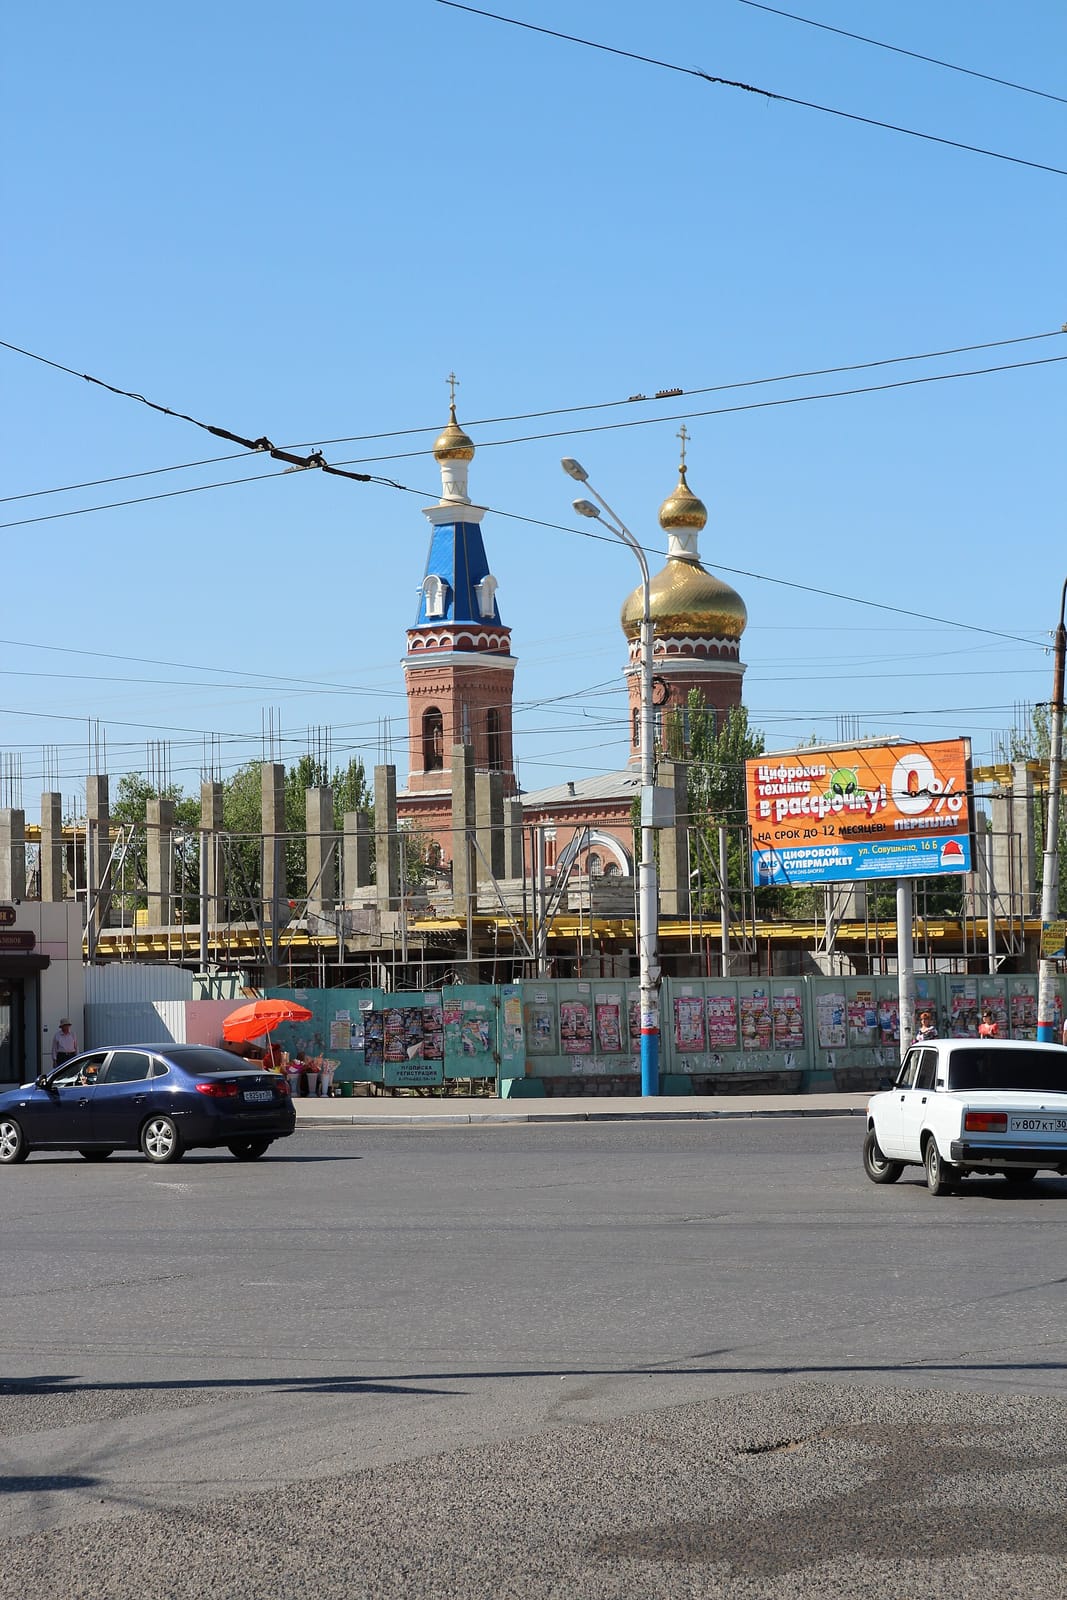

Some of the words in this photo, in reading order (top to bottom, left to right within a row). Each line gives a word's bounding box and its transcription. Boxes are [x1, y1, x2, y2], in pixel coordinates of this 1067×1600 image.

[759, 765, 825, 781] Цифровая
[758, 781, 810, 794] техника
[891, 753, 963, 815] 0%
[759, 802, 771, 818] в
[775, 785, 887, 821] рассрочку!
[894, 814, 960, 832] ПЕРЕПЛАТ
[758, 832, 772, 842] НА
[774, 829, 801, 840] СРОК
[803, 827, 818, 839] ДО
[822, 825, 835, 837] 12
[838, 823, 887, 836] МЕСЯЦЕВ!
[783, 847, 839, 859] ЦИФРОВОЙ
[858, 848, 870, 856] ул.
[871, 844, 918, 856] Савушкина,
[921, 840, 930, 850] 16
[932, 840, 938, 849] Б
[784, 857, 853, 869] СУПЕРМАРКЕТ
